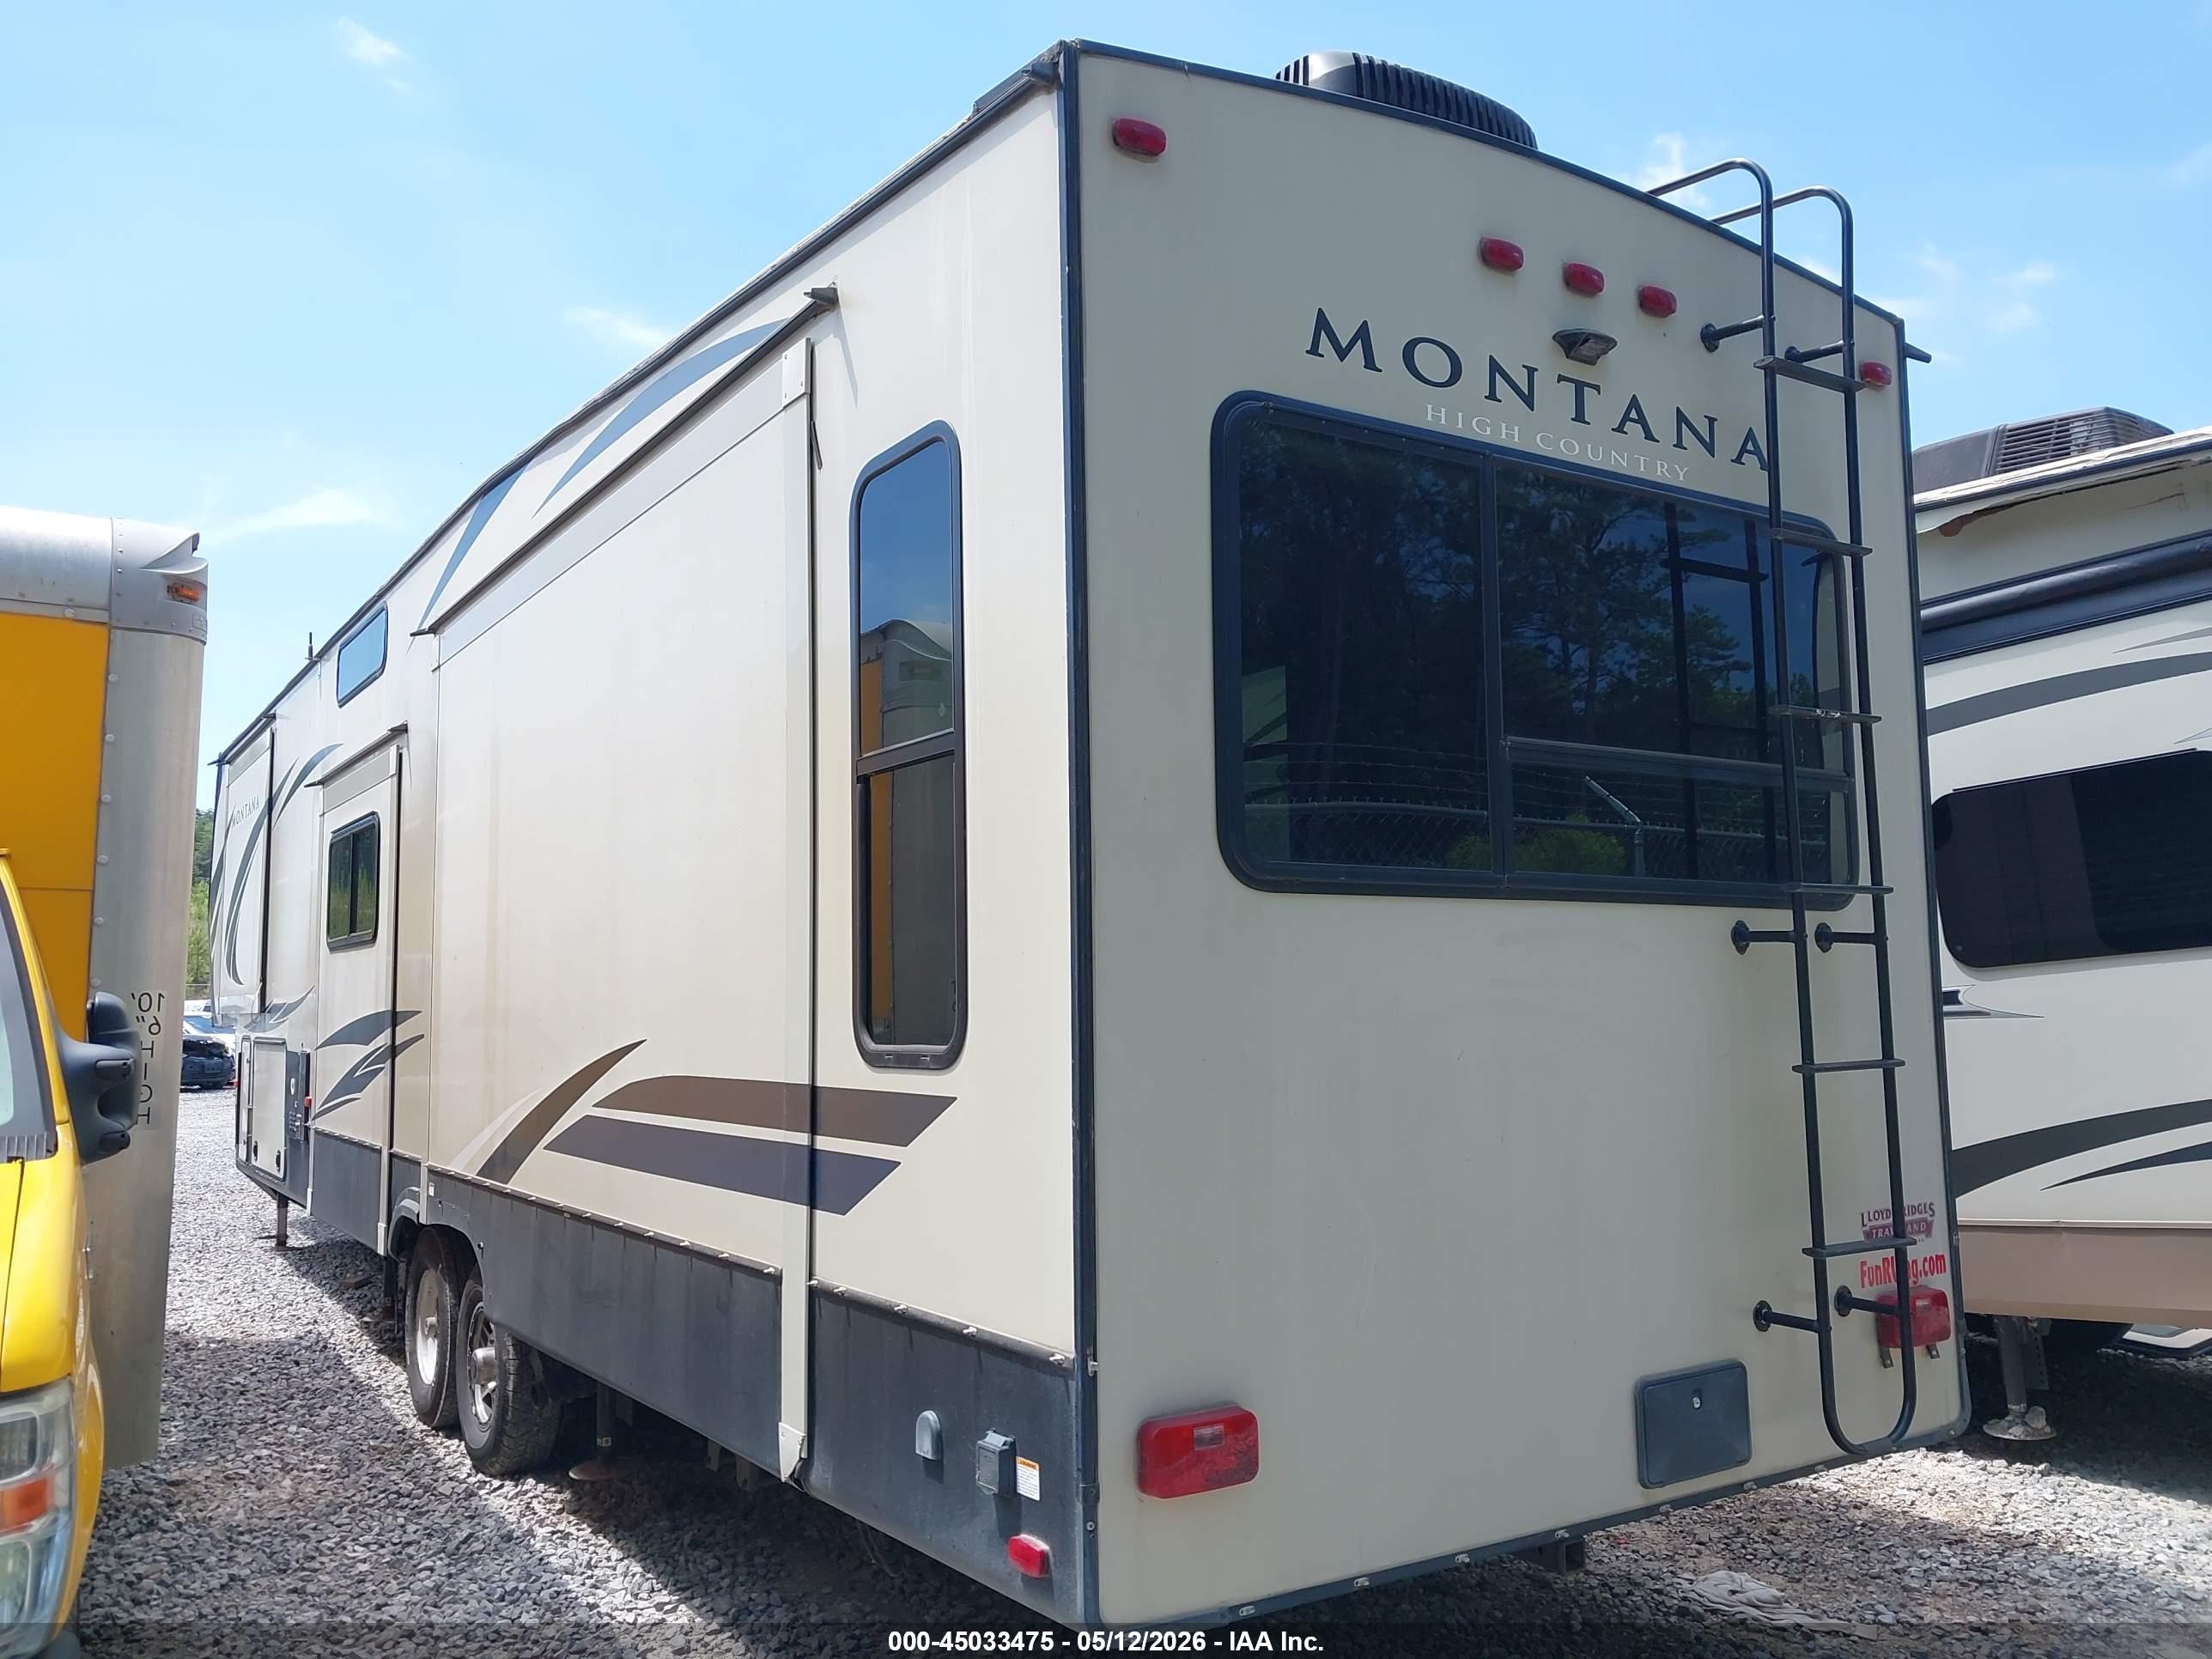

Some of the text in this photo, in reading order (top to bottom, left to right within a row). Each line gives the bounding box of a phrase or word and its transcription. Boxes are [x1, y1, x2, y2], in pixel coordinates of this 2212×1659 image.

[1305, 307, 1770, 471] MONTANA
[1425, 403, 1690, 482] HIGH COUNTRY
[231, 796, 260, 828] MONTANA
[1861, 1208, 1891, 1227] LLOYD
